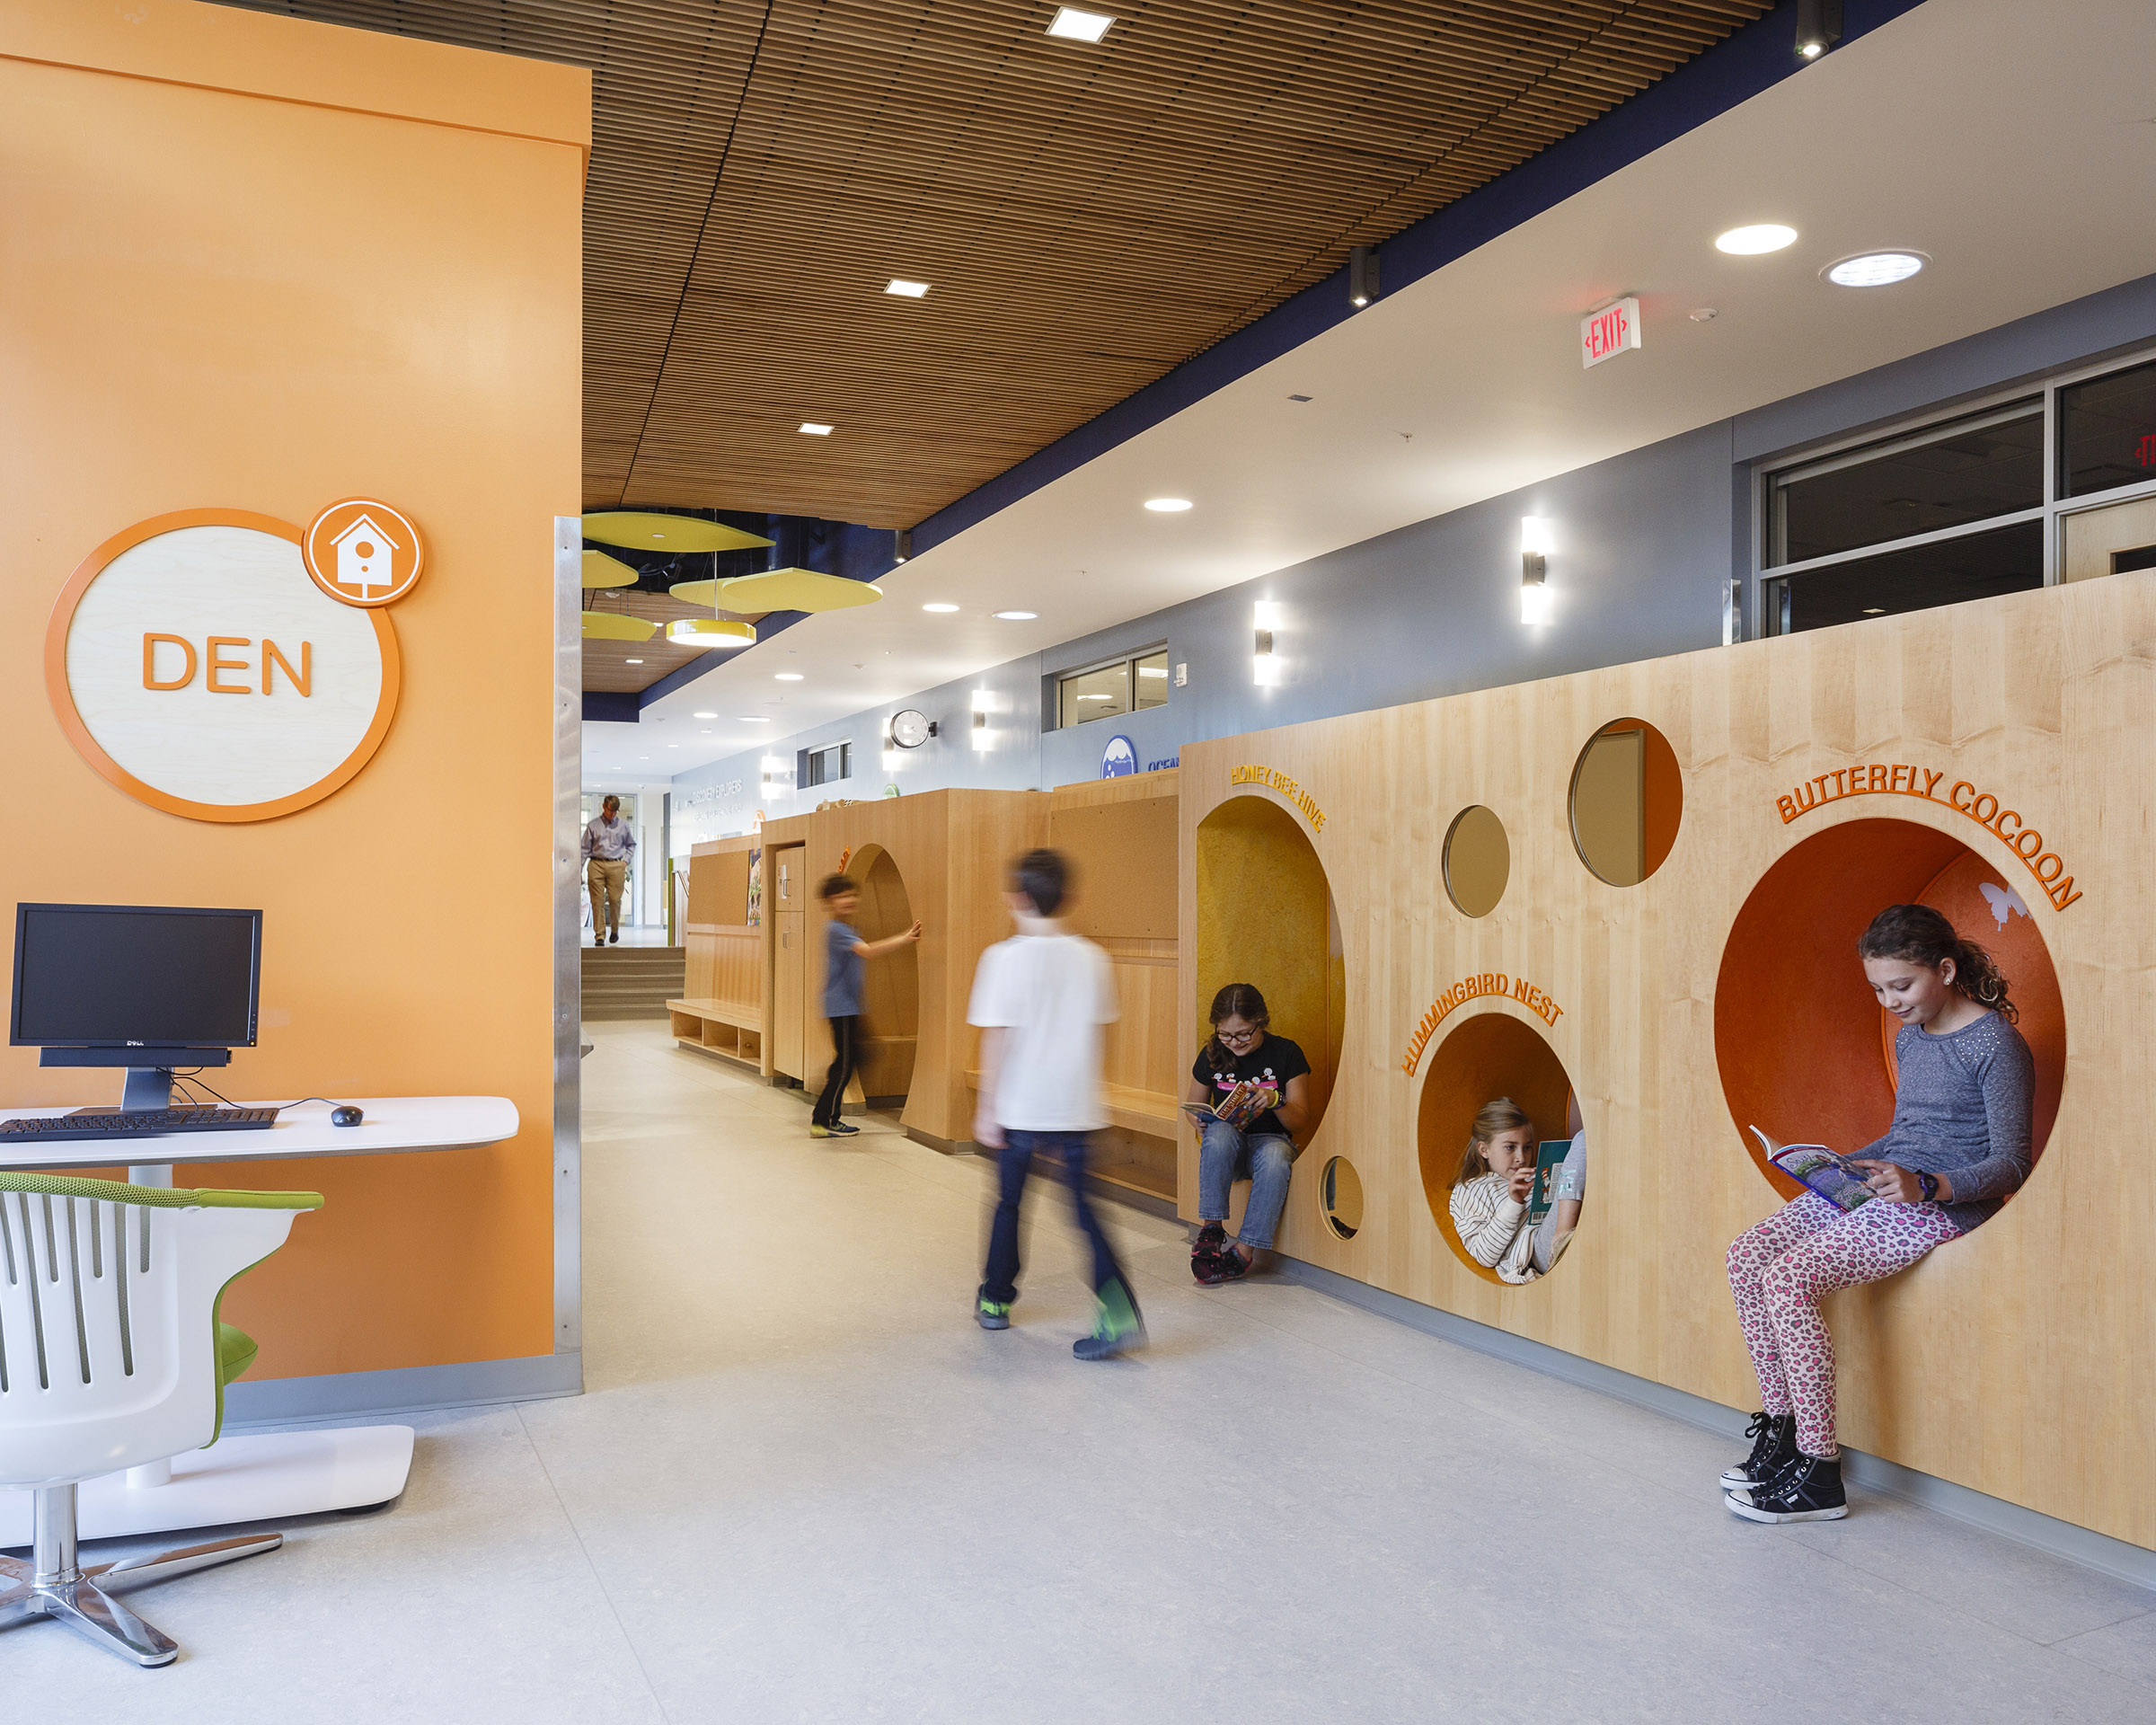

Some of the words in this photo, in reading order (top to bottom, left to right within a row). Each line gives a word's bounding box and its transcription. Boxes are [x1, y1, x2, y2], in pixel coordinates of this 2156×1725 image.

[1589, 307, 1622, 358] EXIT
[143, 632, 311, 698] DEN
[1231, 764, 1272, 786] HONEY
[1273, 770, 1298, 800] BEE
[1297, 790, 1326, 834] HIVE
[1775, 764, 1944, 825] BUTTERFLY
[1949, 781, 2083, 912] COCOON
[1401, 972, 1509, 1077] HUMMINGBIRD
[1513, 978, 1564, 1027] NEST
